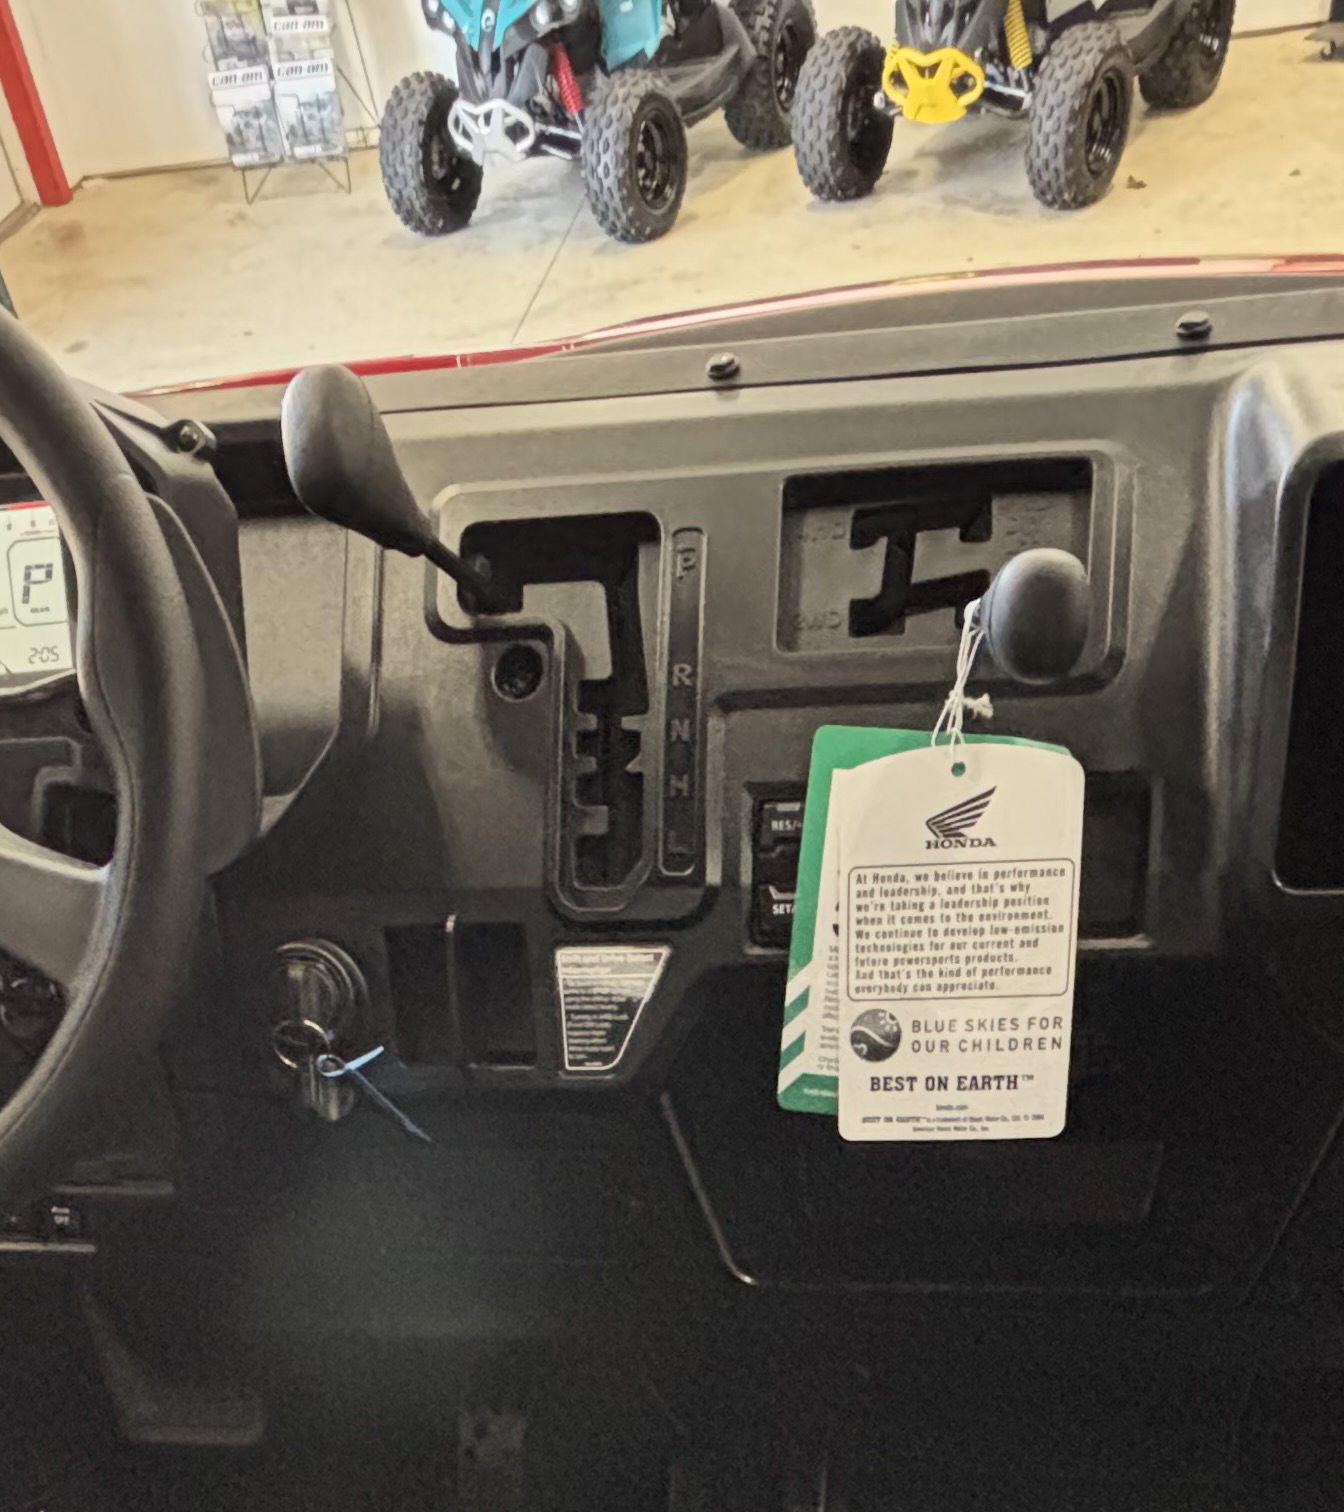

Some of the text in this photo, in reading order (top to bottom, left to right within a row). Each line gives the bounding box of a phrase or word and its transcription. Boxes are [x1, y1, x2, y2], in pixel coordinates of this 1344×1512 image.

[676, 546, 697, 579] P
[22, 563, 53, 604] P
[28, 646, 60, 664] 2:05
[672, 663, 692, 687] R
[670, 718, 691, 742] N
[669, 774, 689, 797] H
[925, 838, 997, 849] HONDA
[856, 868, 1065, 885] At Honda, we believe in performance
[856, 882, 1030, 898] and leadership, and that's why
[856, 896, 1049, 912] we're taking a leadership position
[856, 909, 1052, 925] when it comes to the environment.
[856, 923, 1064, 939] We continue to develop low-emission
[856, 937, 1039, 954] technologies for our current and
[856, 952, 1017, 967] future powersports products.
[856, 966, 1052, 980] And that's the kind of performance
[855, 981, 999, 995] everybody can appreciate.
[912, 1016, 1063, 1033] BLUE SKIES FOR
[911, 1036, 1062, 1053] OUR CHILDREN
[870, 1076, 918, 1092] BEST
[925, 1076, 949, 1091] ON
